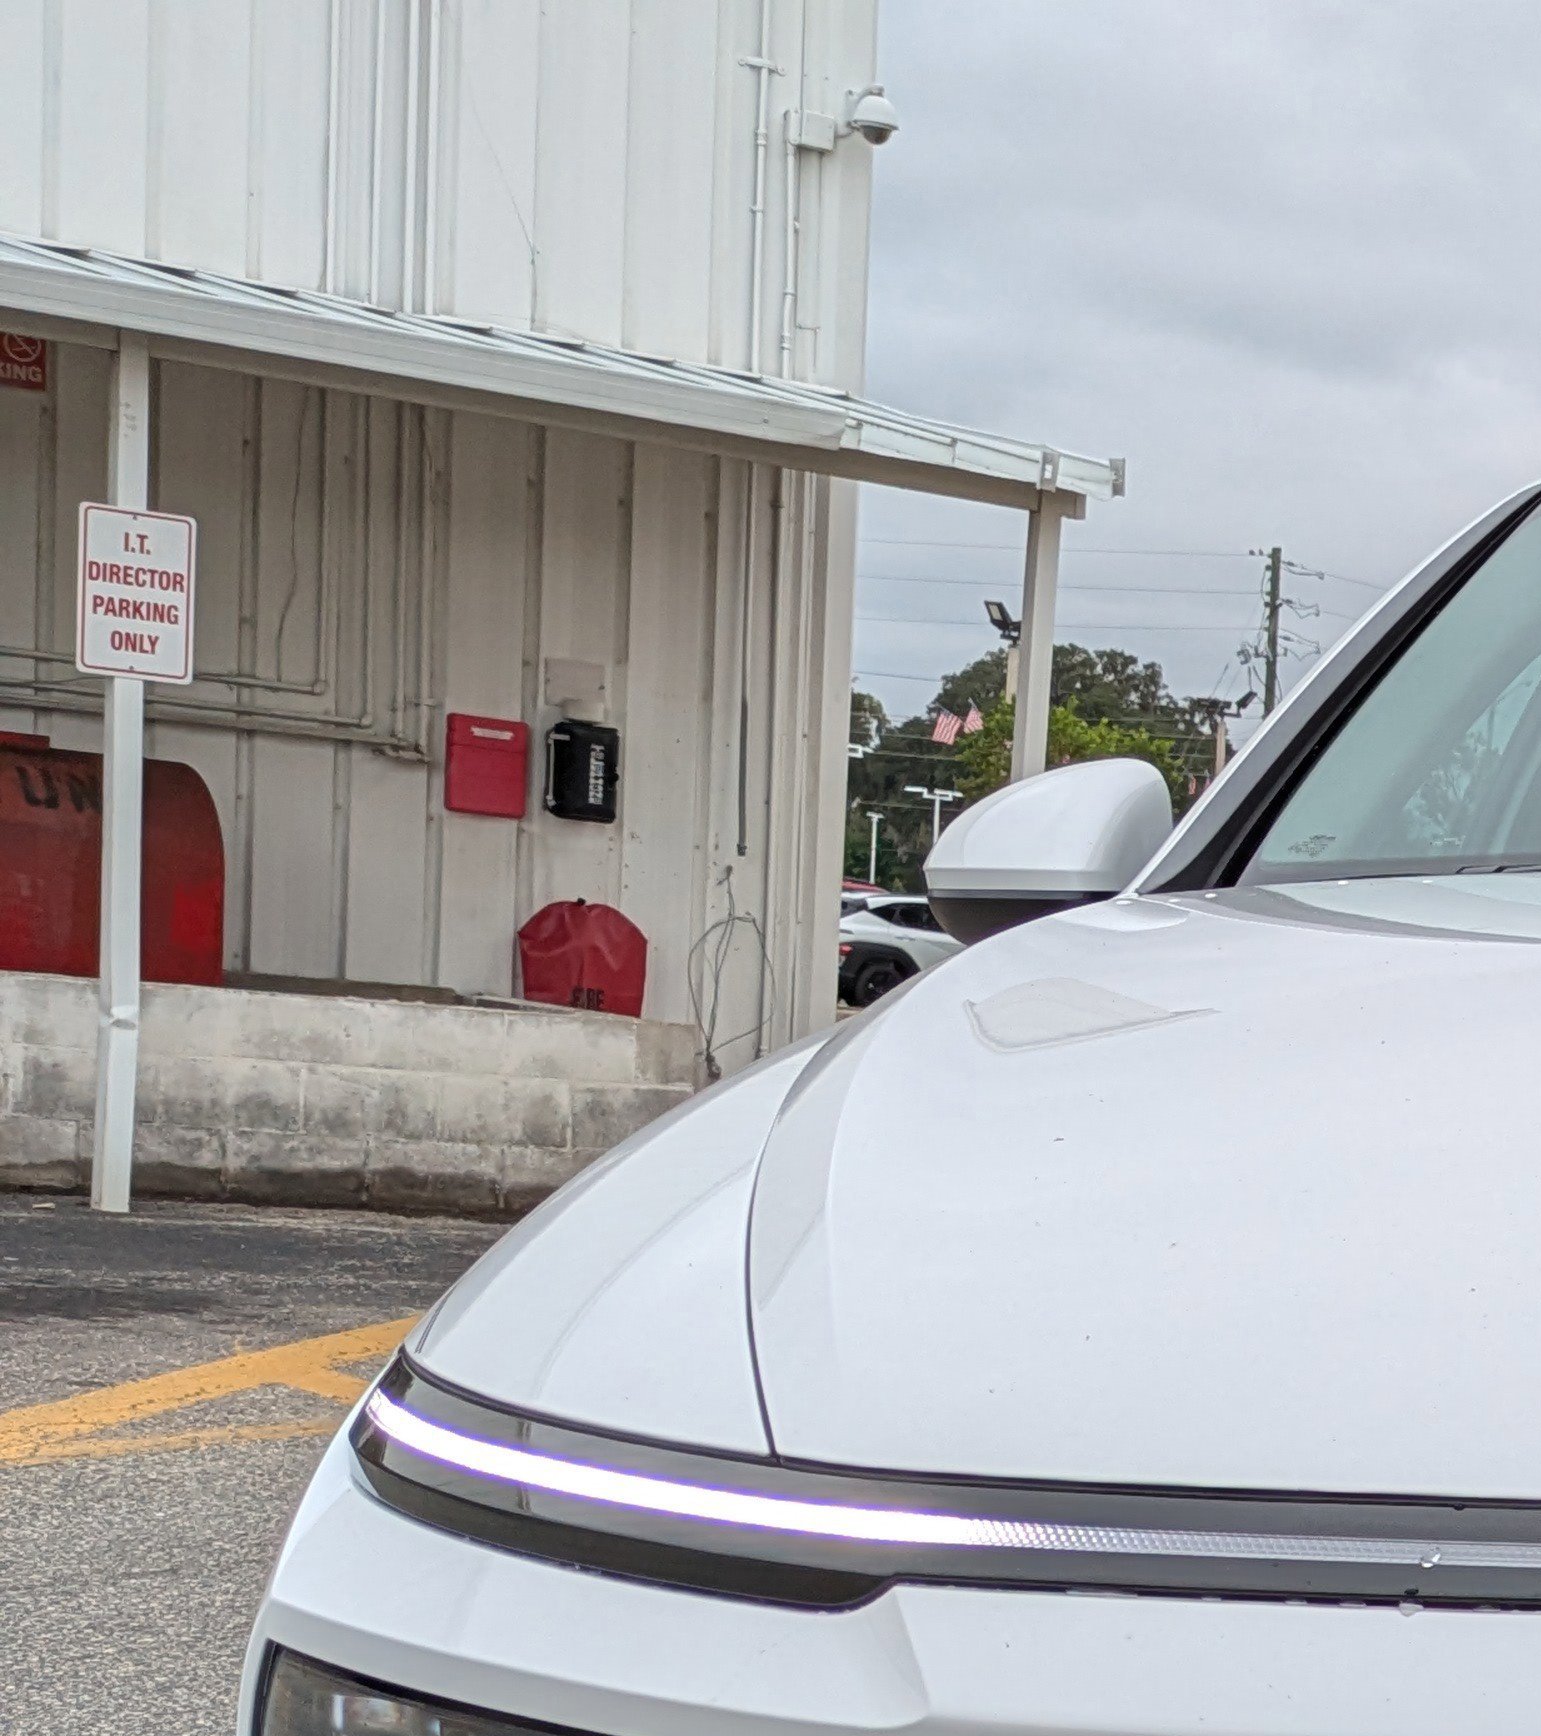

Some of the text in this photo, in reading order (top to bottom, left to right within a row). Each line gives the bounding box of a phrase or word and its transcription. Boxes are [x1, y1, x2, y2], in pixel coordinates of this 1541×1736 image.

[122, 531, 152, 556] I.T.
[88, 560, 186, 594] DIRECTOR
[92, 594, 180, 626] PARKING
[110, 630, 160, 656] ONLY
